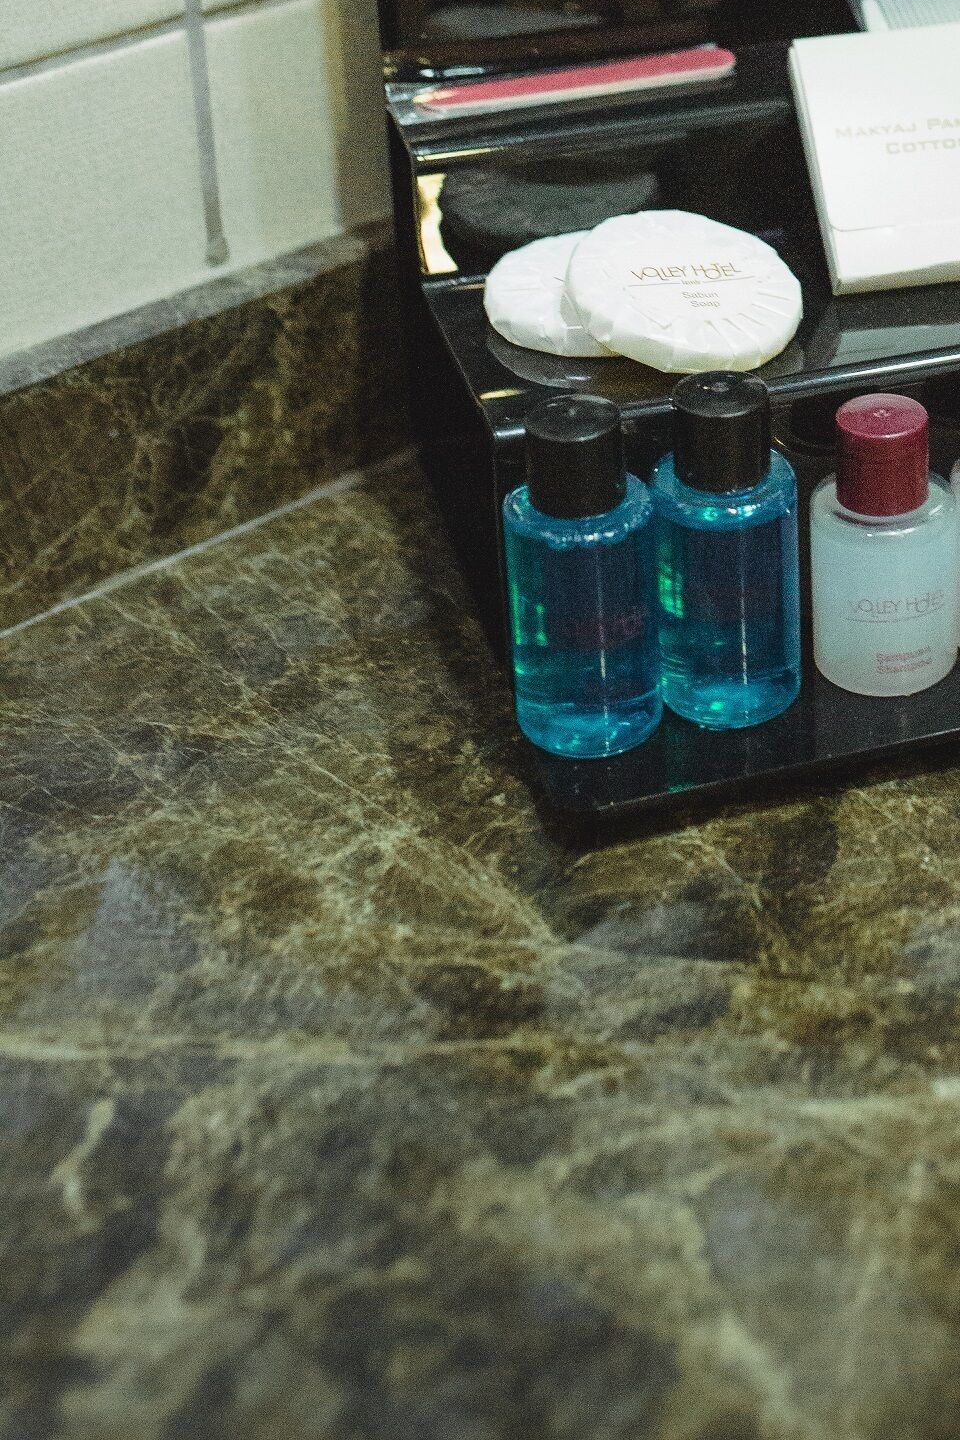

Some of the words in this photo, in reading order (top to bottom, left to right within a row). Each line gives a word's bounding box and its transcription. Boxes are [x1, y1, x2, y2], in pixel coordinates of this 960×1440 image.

[691, 261, 741, 280] HOTEL
[682, 291, 720, 300] Sabun
[690, 300, 721, 308] Soap
